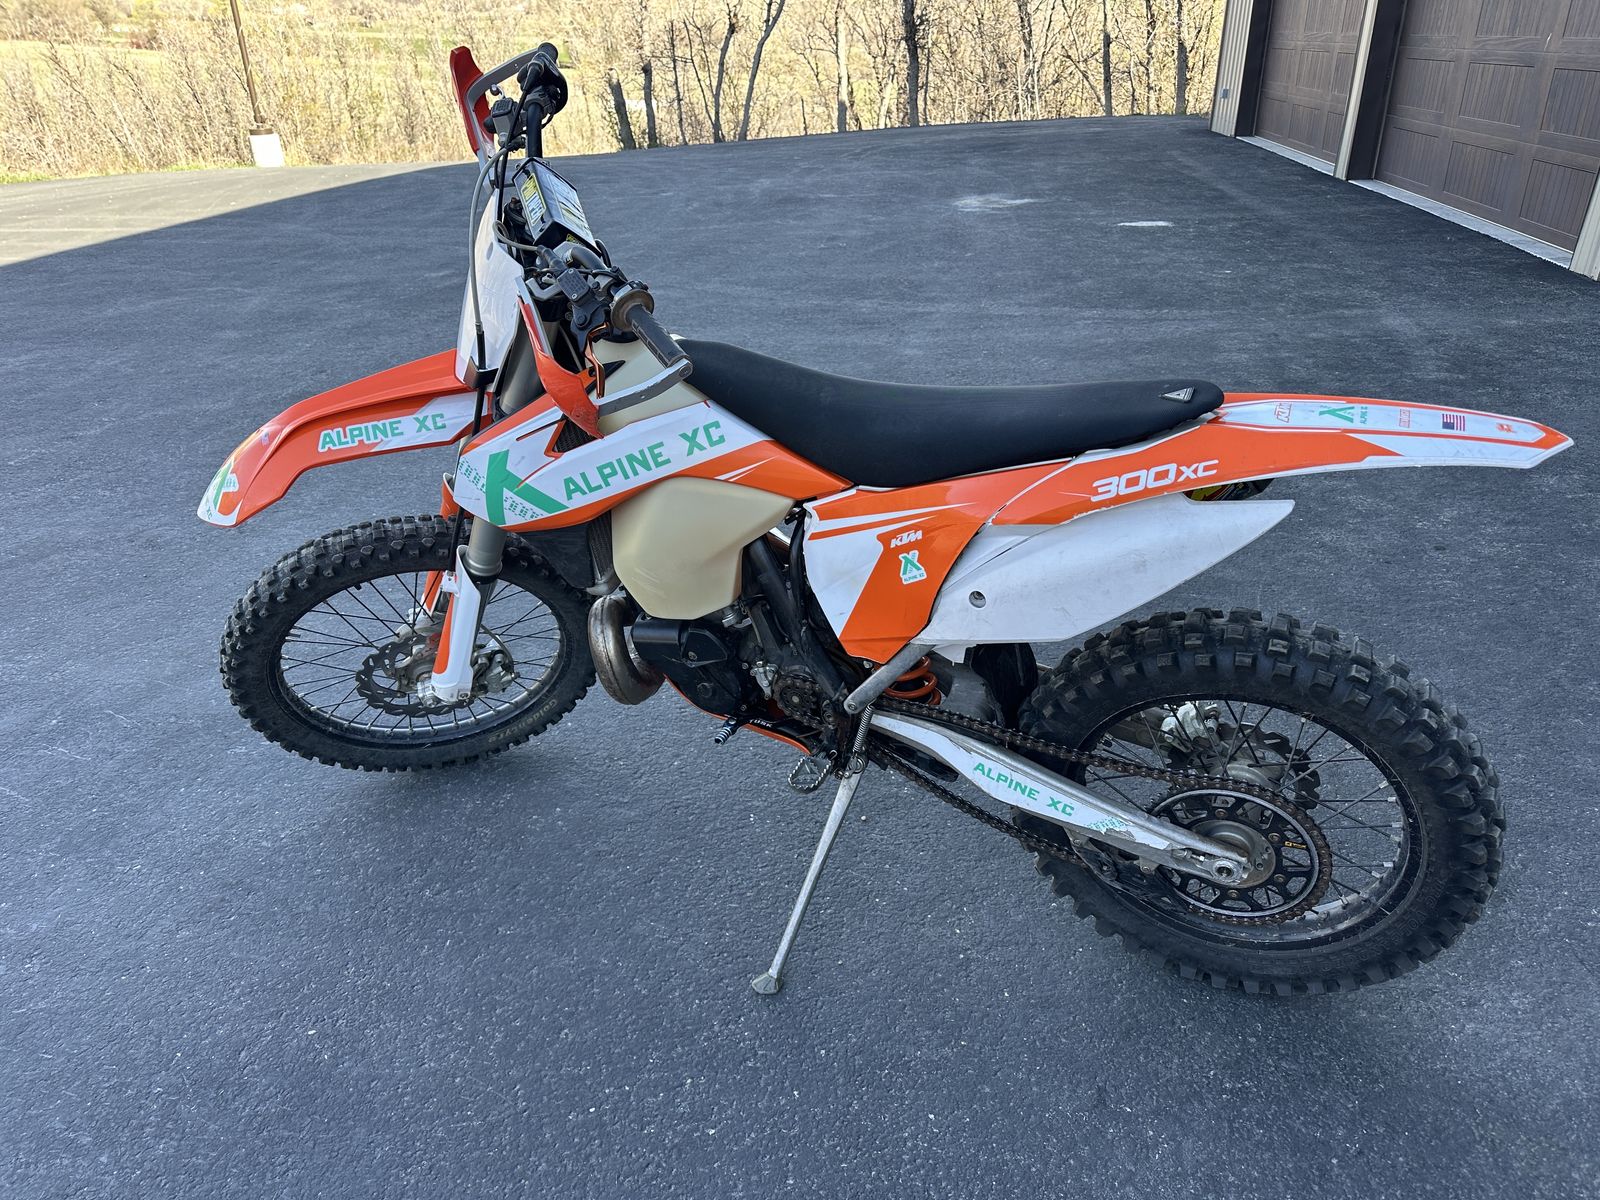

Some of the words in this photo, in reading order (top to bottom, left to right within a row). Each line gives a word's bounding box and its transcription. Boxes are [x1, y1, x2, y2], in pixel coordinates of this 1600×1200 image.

[320, 419, 404, 450] ALPINE
[413, 412, 447, 434] XC
[563, 441, 672, 501] ALPINE
[678, 420, 727, 457] XC
[890, 530, 922, 548] KTM
[973, 762, 1040, 801] ALPINE
[1046, 797, 1075, 817] XC
